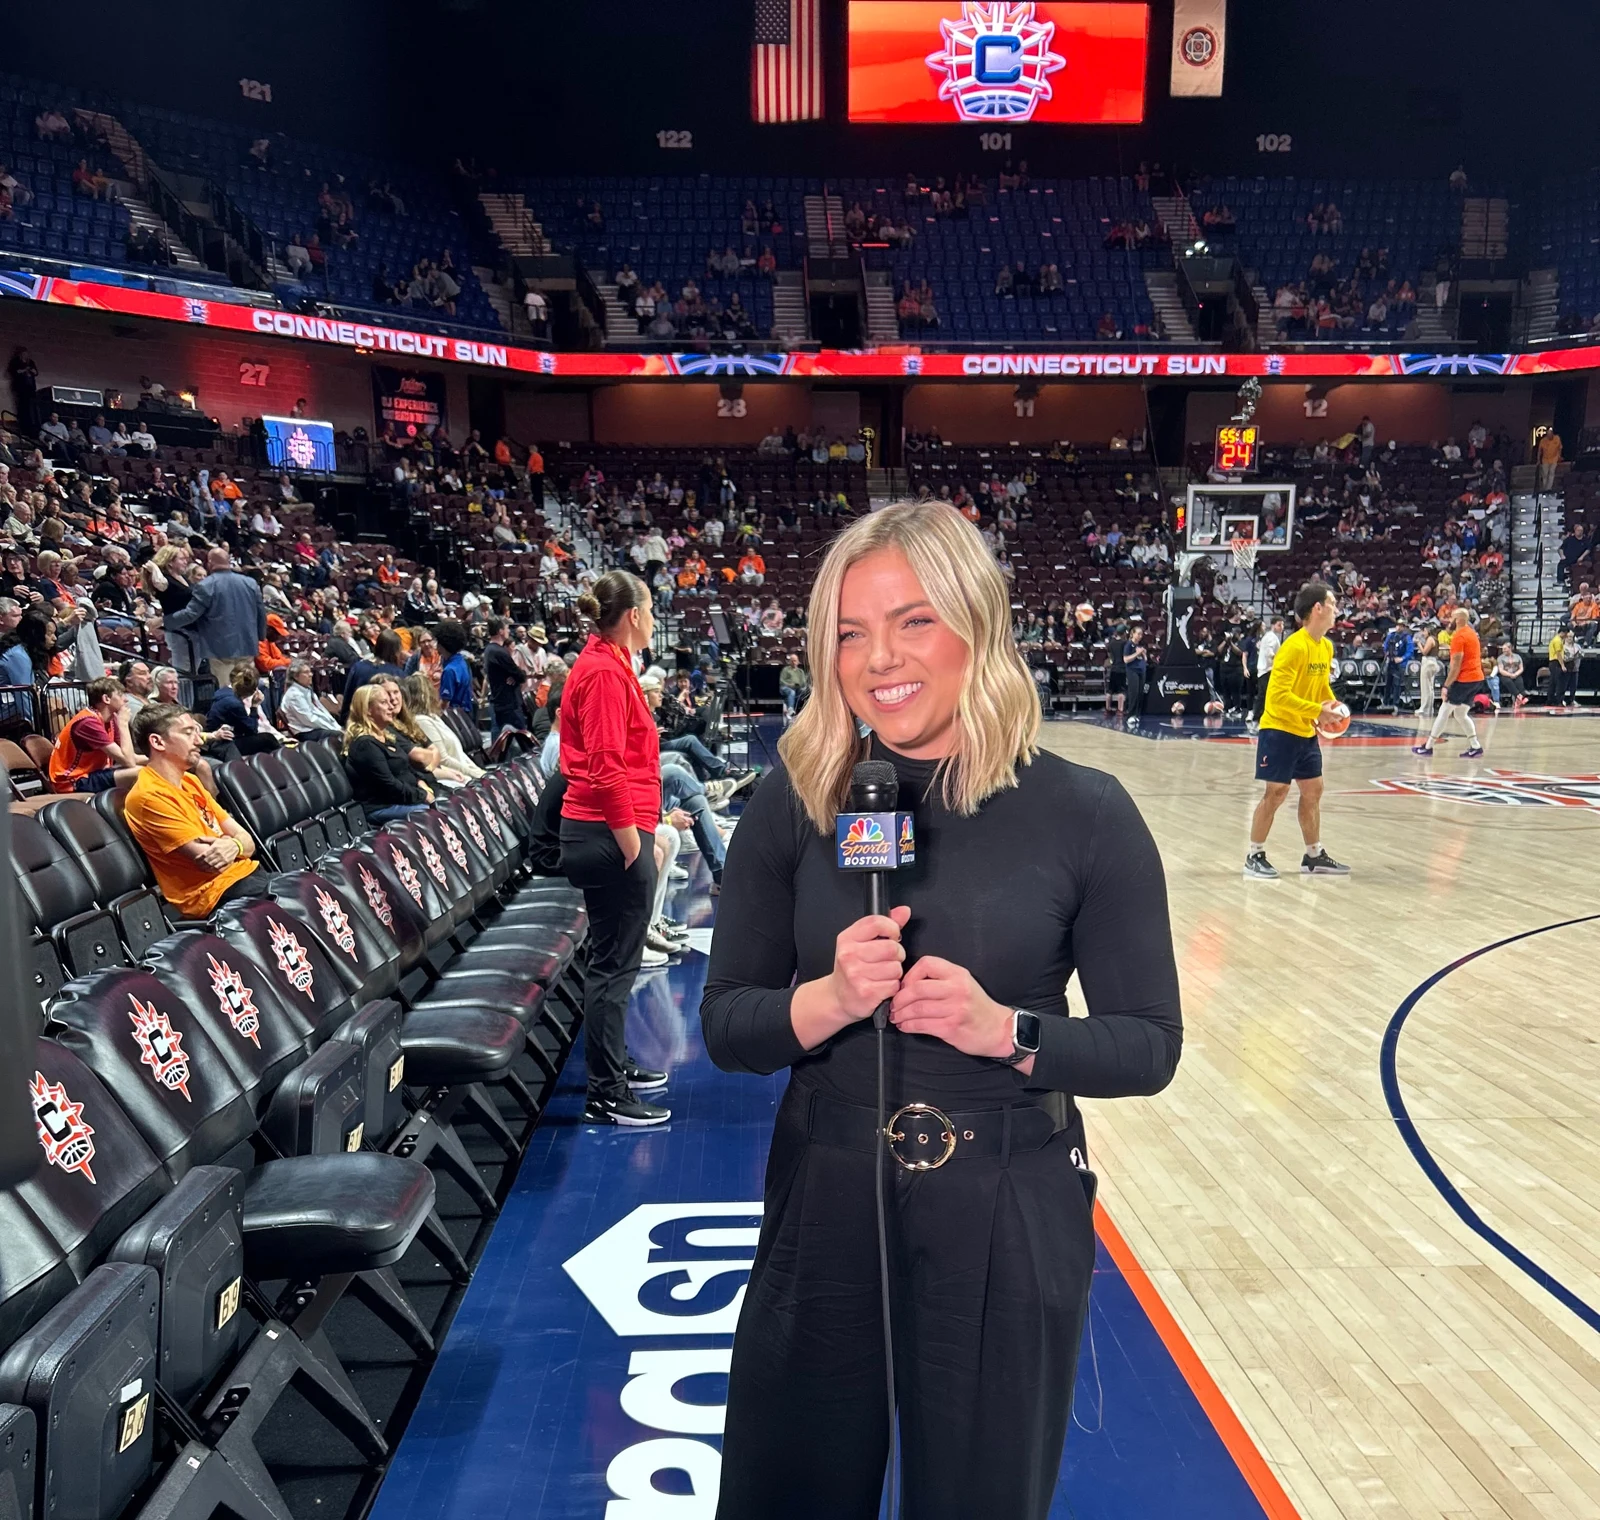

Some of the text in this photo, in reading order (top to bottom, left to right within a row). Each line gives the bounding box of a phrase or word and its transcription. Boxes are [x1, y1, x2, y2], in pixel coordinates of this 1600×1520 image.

[238, 78, 272, 102] 121
[656, 130, 692, 148] 122
[979, 132, 1012, 151] 101
[1256, 133, 1291, 152] 102
[252, 310, 508, 367] CONNECTICUT SUN
[239, 362, 270, 387] 27
[962, 356, 1226, 375] CONNECTICUT SUN
[717, 399, 747, 418] 28
[1013, 399, 1035, 418] 11
[1303, 399, 1328, 418] 12
[1219, 427, 1256, 444] 55:18
[1221, 444, 1250, 468] 24
[840, 839, 892, 858] Sports
[844, 856, 888, 865] BOSTON
[221, 1280, 240, 1324] B9
[122, 1397, 149, 1448] B8
